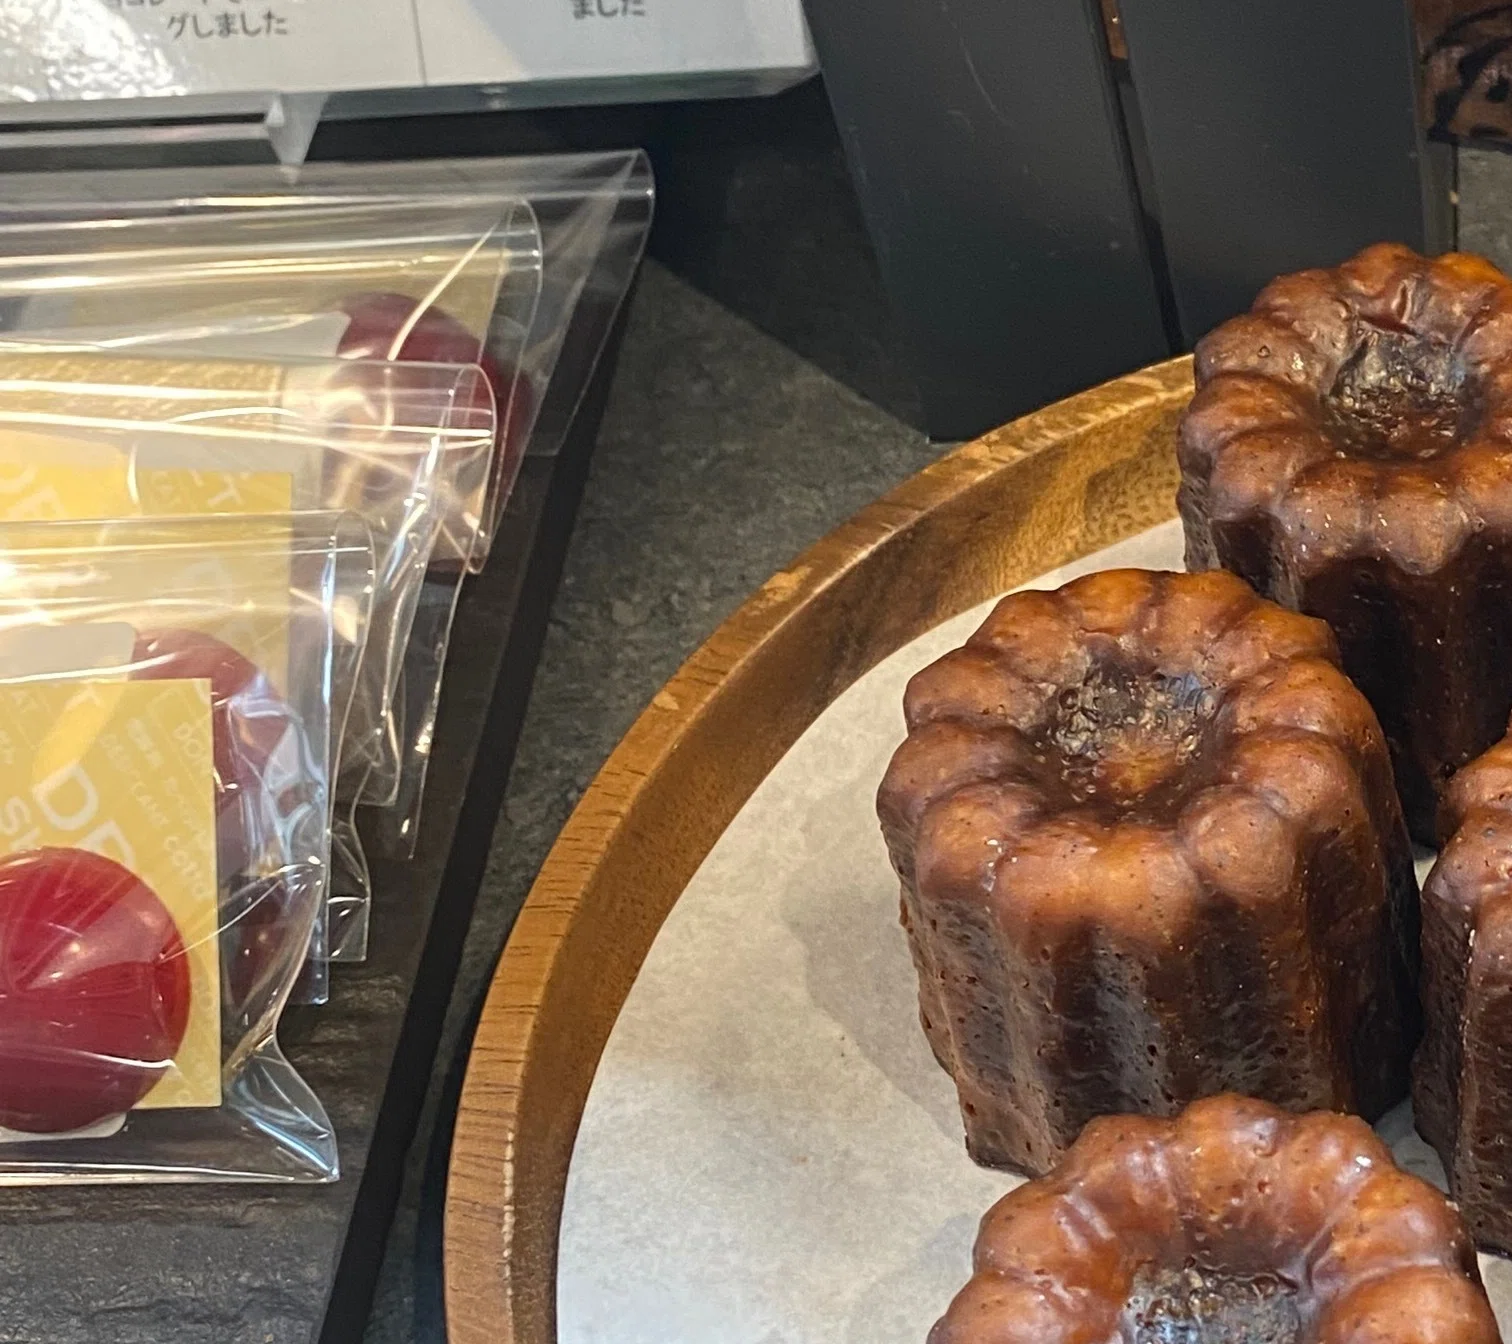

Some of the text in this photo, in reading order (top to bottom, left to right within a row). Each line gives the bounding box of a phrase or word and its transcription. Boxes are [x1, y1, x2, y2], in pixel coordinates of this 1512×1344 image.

[167, 9, 290, 40] グしました
